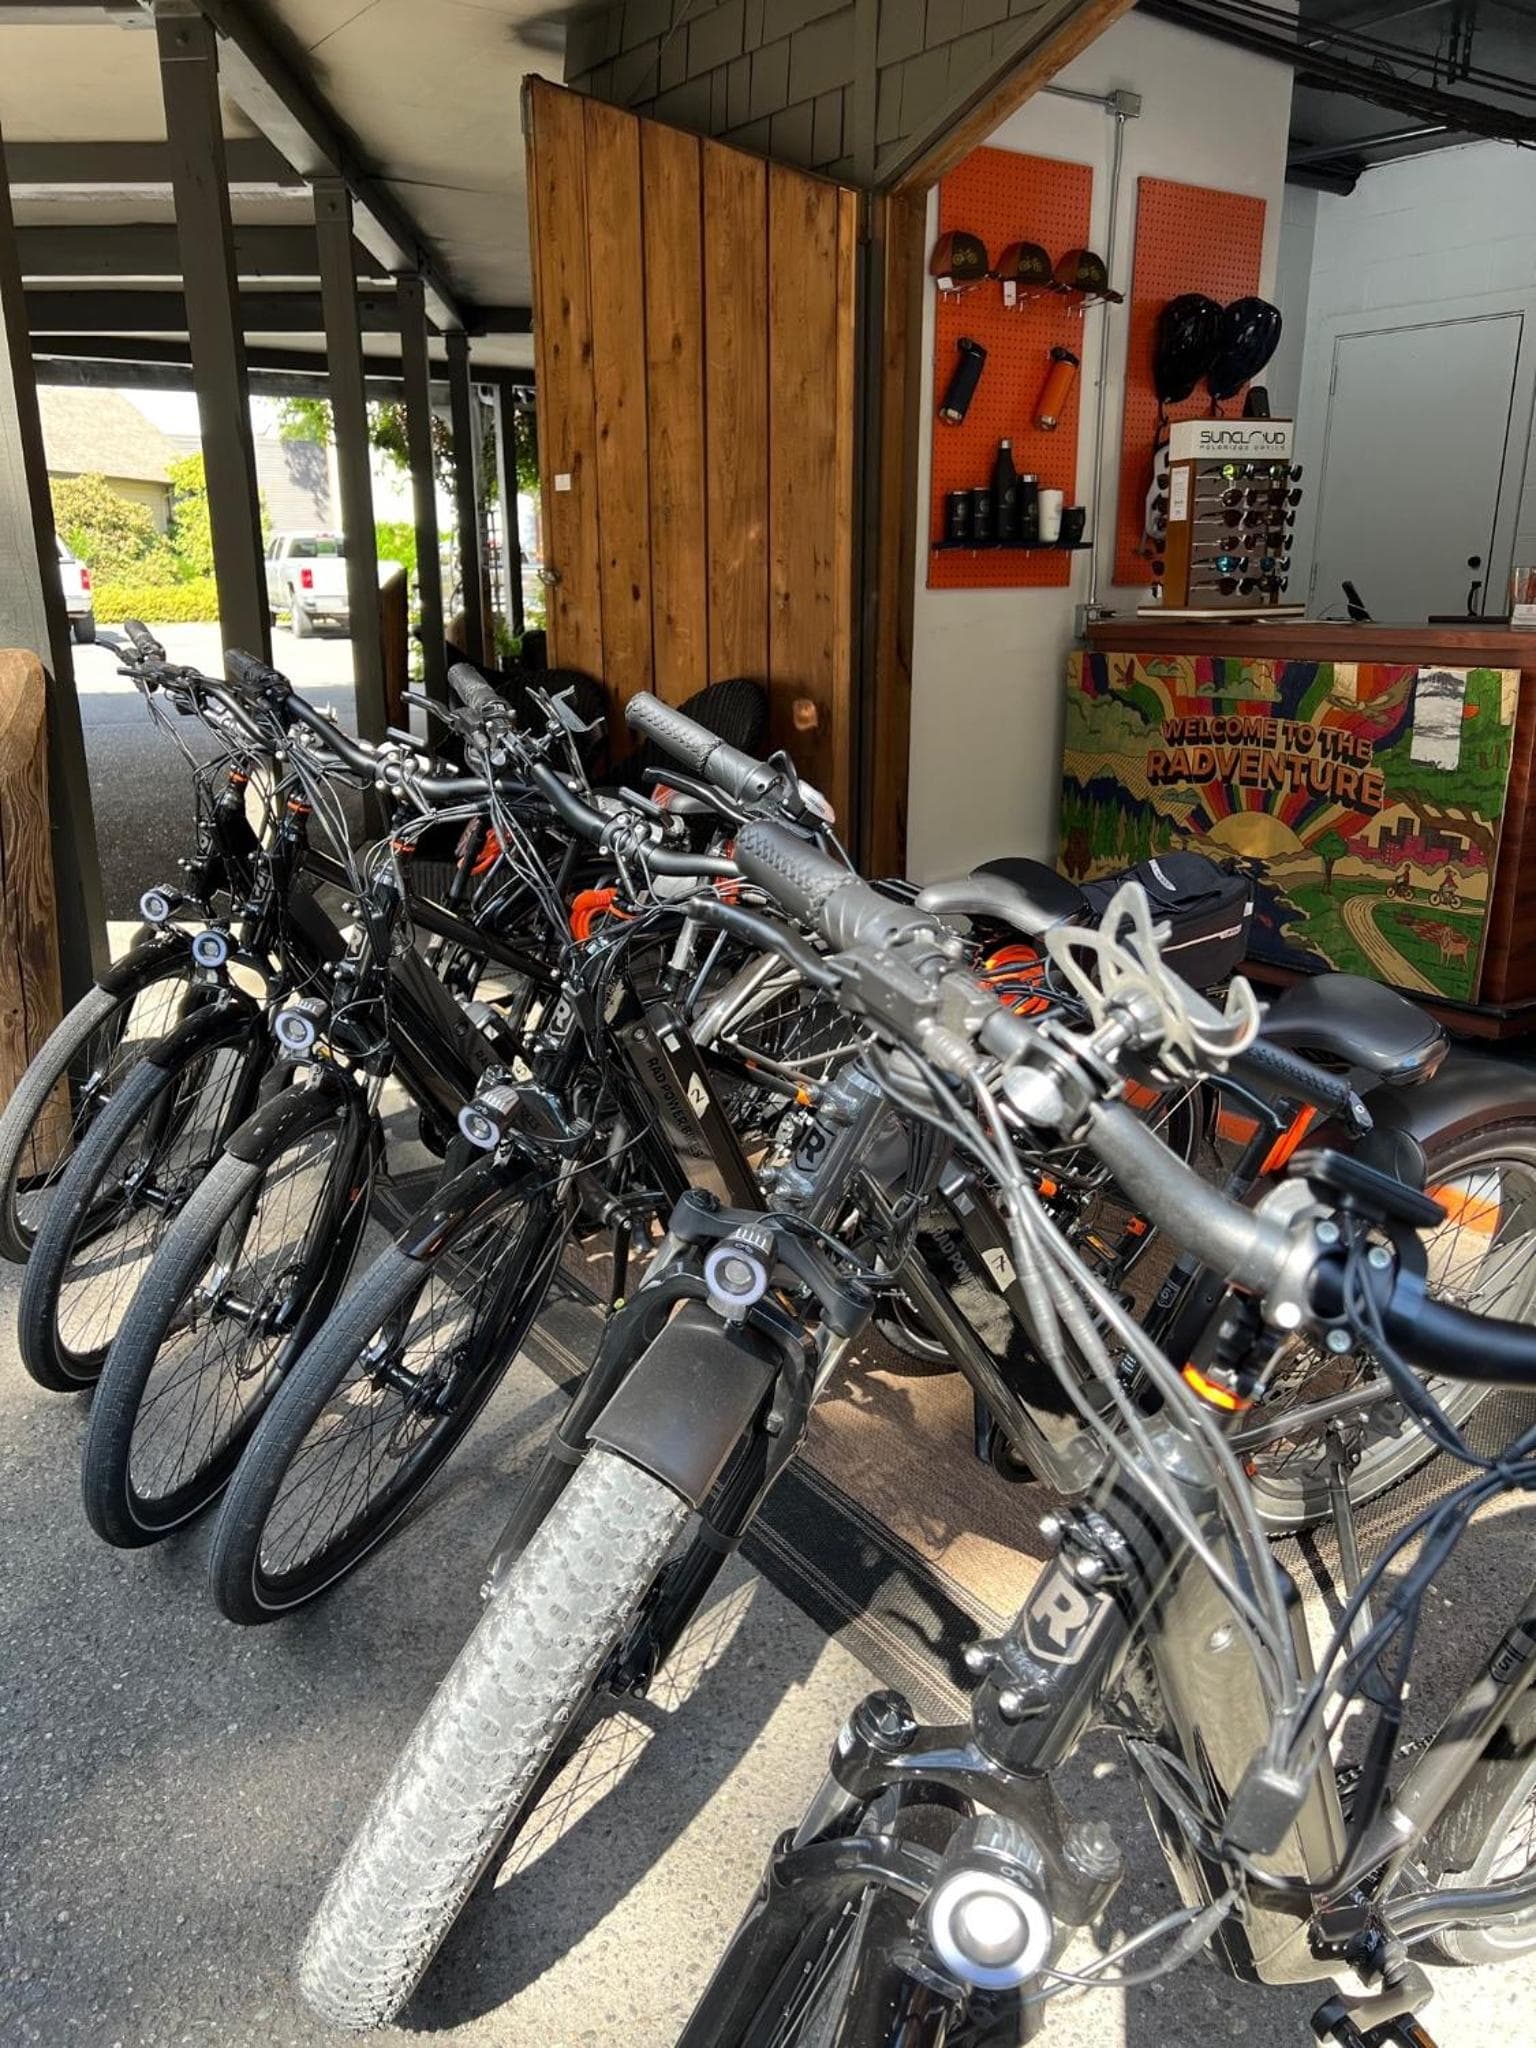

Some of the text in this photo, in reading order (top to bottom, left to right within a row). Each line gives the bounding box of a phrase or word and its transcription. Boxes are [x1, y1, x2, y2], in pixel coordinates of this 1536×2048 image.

[1200, 431, 1285, 444] SUNCLOUD
[1162, 717, 1372, 768] WELCOME TO THE
[1147, 748, 1384, 815] RADVENTURE
[647, 1058, 666, 1082] RAD
[661, 1084, 688, 1126] POWER
[690, 1088, 706, 1104] 2
[800, 1126, 826, 1164] R
[932, 1226, 956, 1254] RAD
[991, 1254, 1007, 1273] 7
[1031, 1570, 1089, 1649] R
